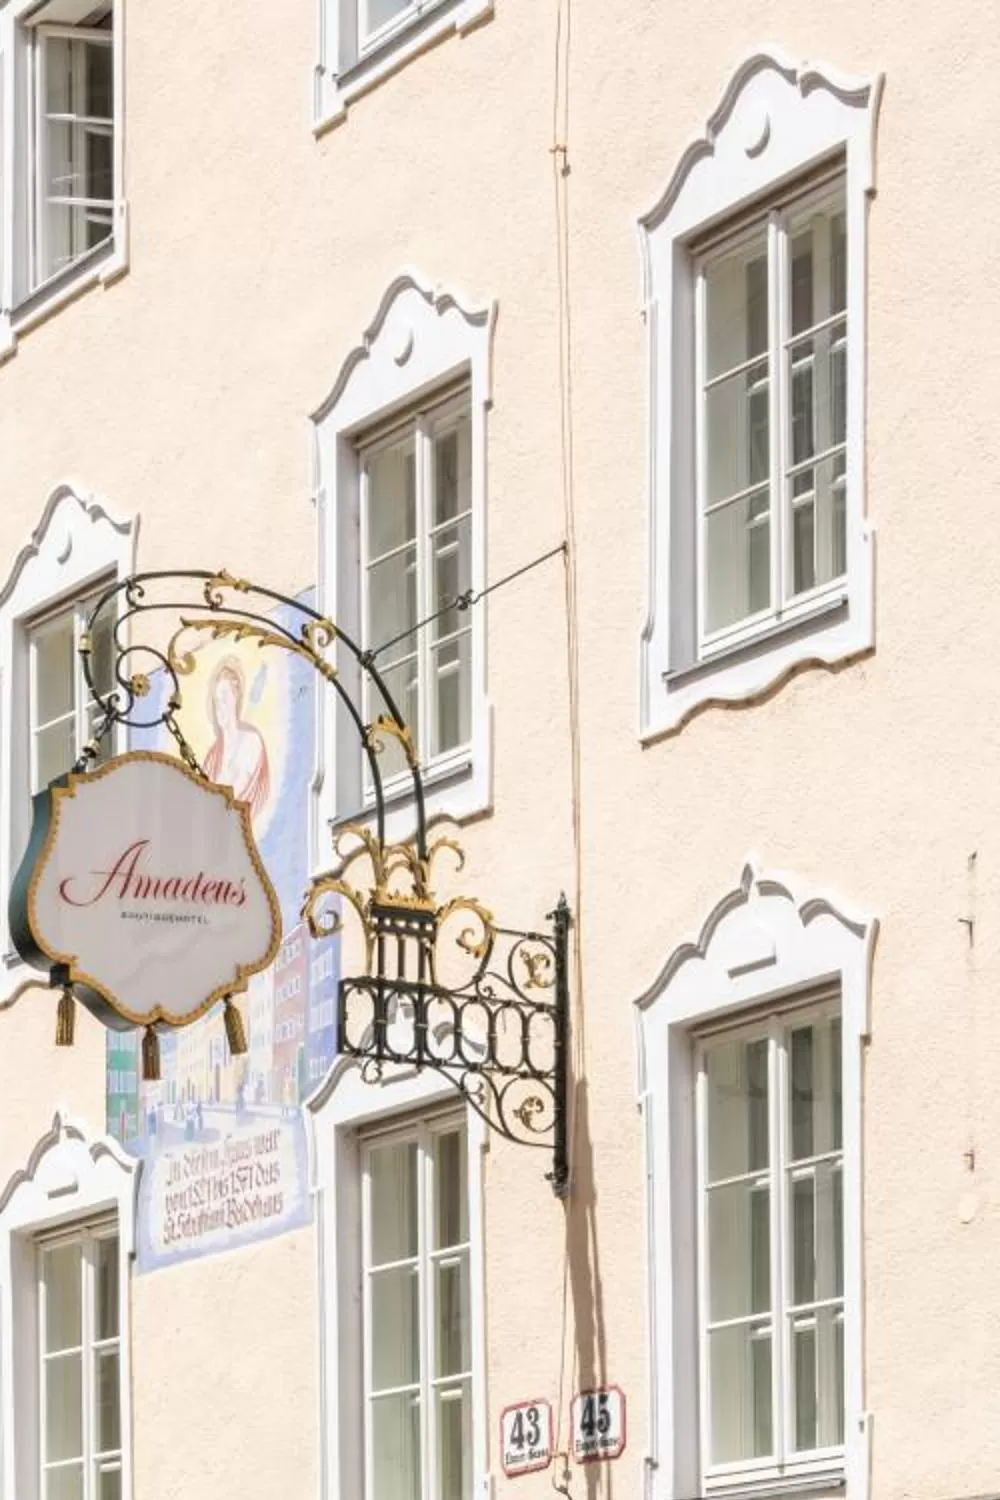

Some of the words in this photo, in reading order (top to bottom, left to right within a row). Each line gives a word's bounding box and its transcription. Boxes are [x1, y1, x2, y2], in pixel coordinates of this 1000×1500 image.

[59, 839, 249, 907] Amadeus
[510, 1406, 541, 1450] 43
[580, 1393, 611, 1437] 45
